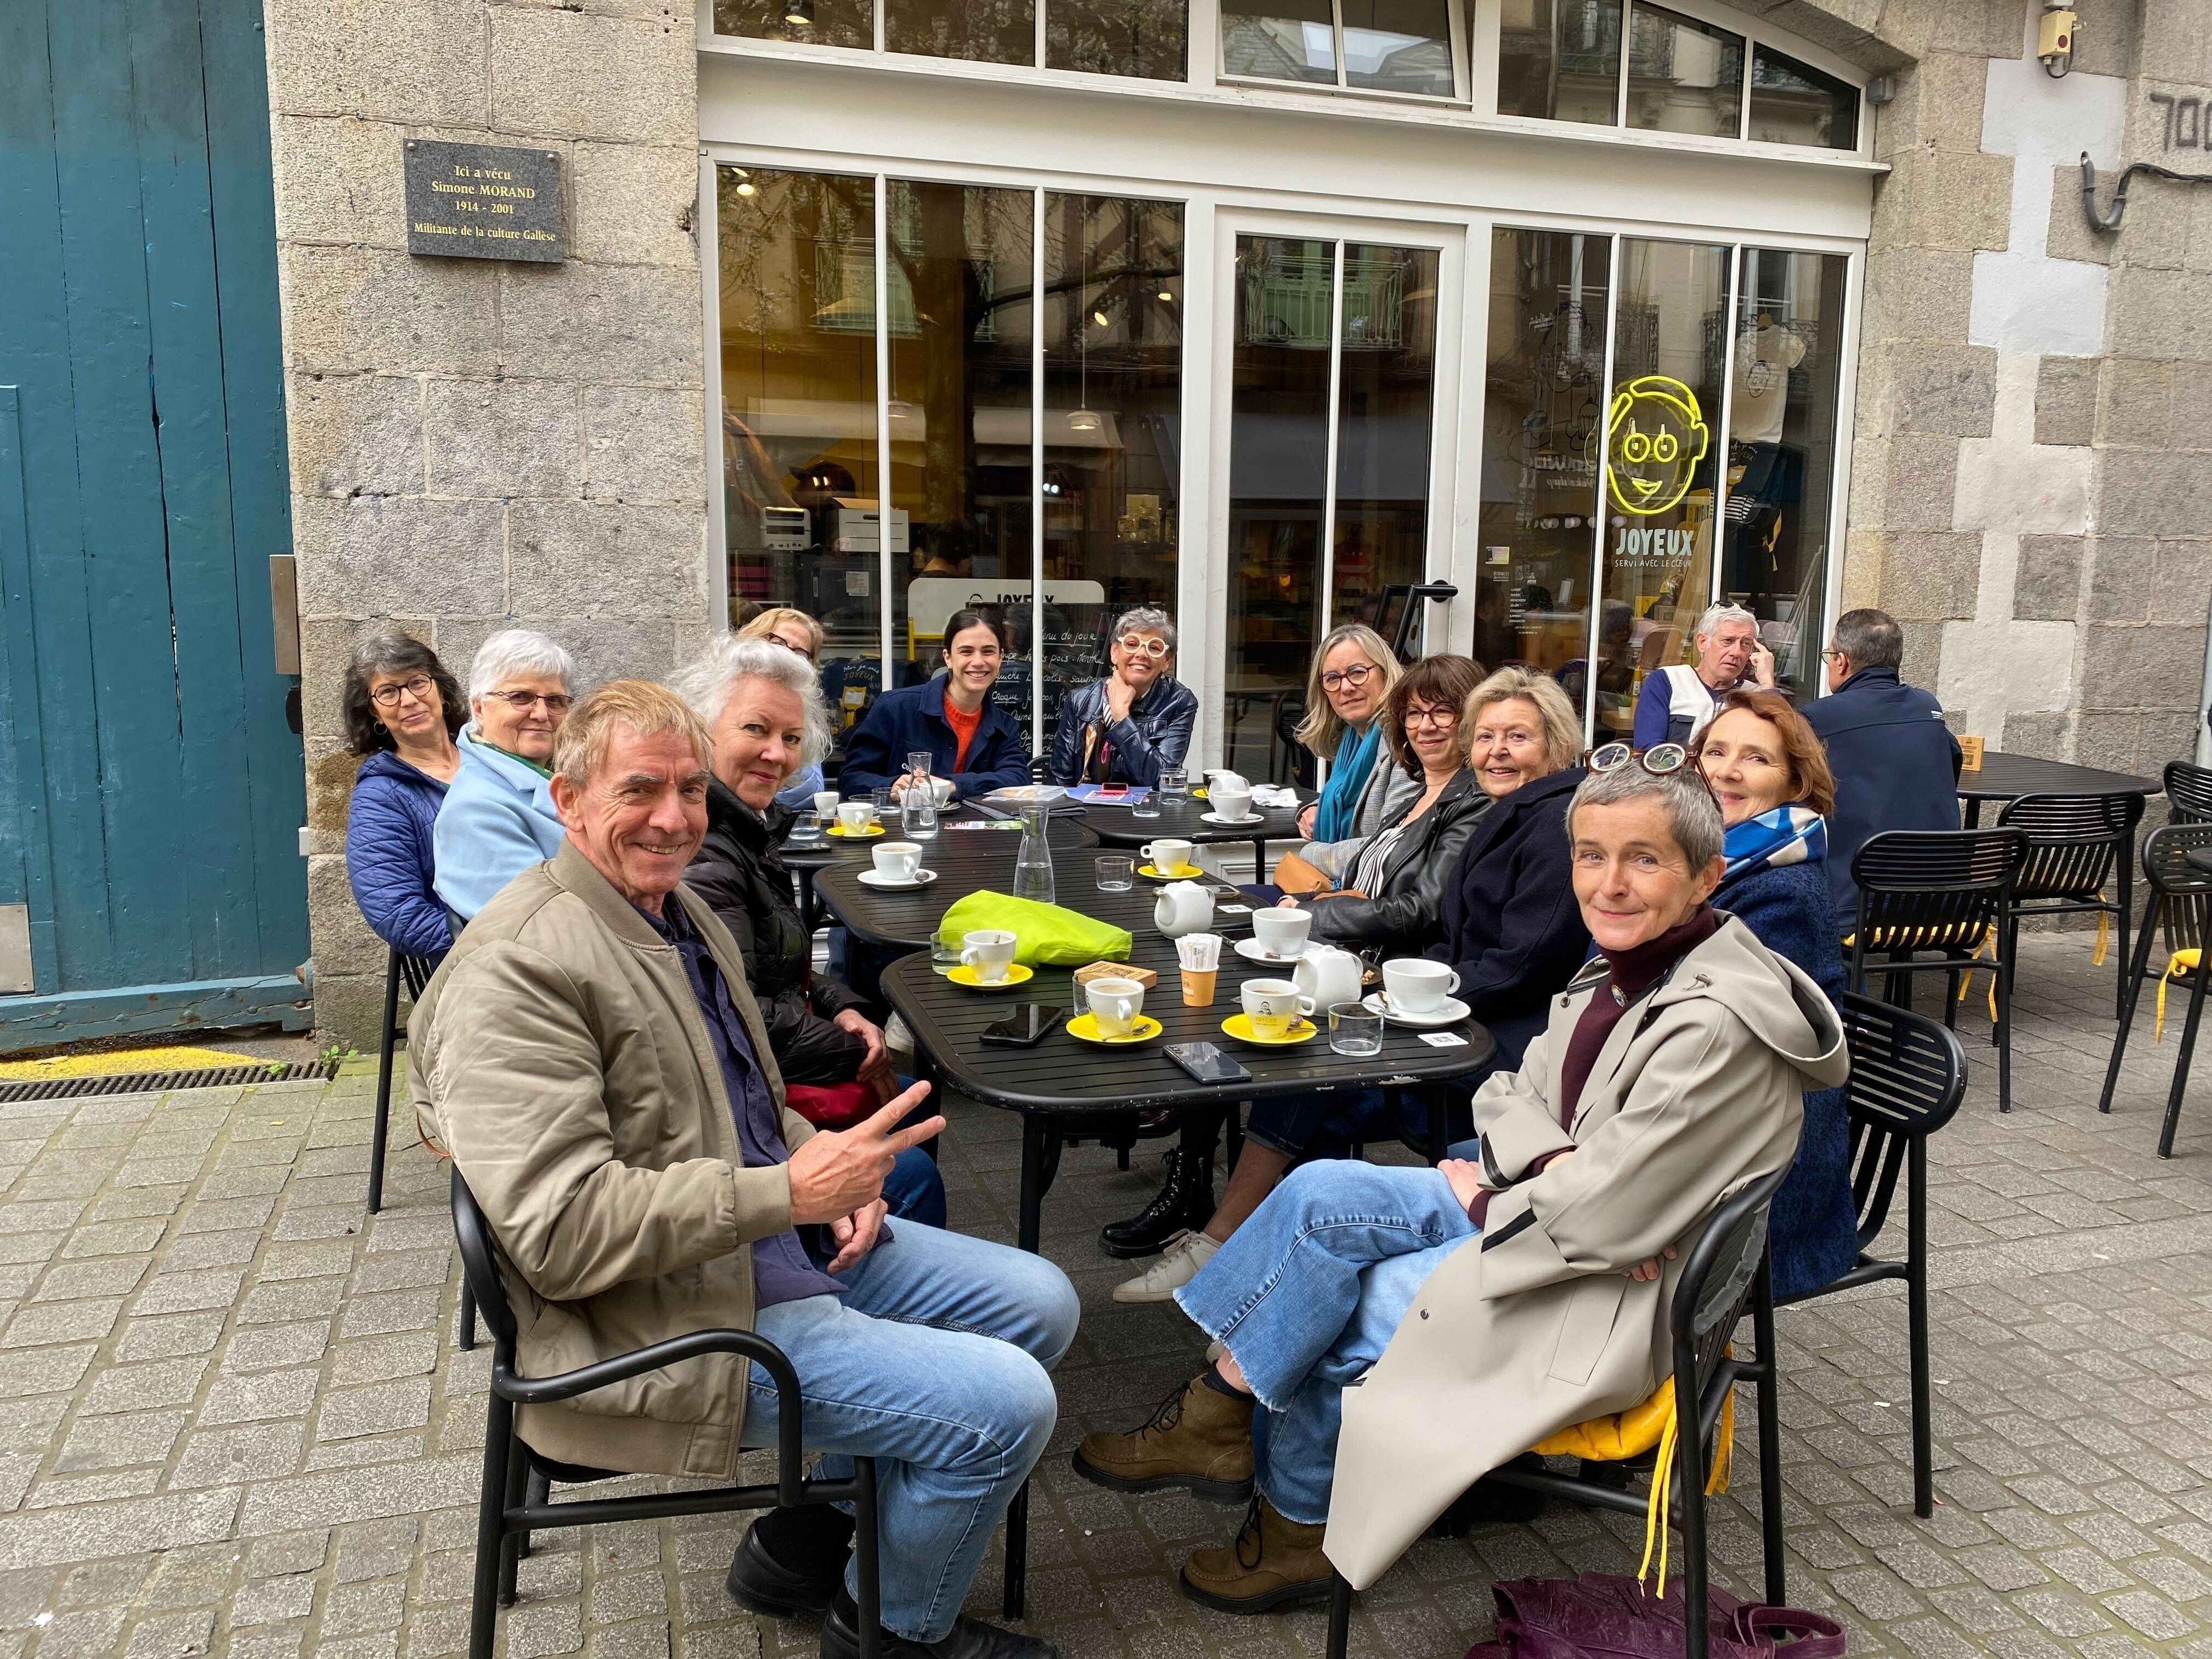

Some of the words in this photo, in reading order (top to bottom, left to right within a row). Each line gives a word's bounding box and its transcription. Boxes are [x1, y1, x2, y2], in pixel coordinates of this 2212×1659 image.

[455, 166, 470, 177] Ici
[474, 170, 481, 178] a
[485, 168, 511, 180] vécu
[432, 181, 475, 195] Simone
[479, 185, 535, 199] MORAND
[455, 201, 479, 212] 1914
[491, 203, 514, 214] 2001
[414, 222, 457, 235] Militante
[461, 225, 472, 236] de
[476, 226, 484, 236] la
[488, 229, 520, 239] culture
[523, 230, 556, 241] Gallèse
[1616, 528, 1694, 556] JOYEUX
[1042, 630, 1057, 641] enu
[843, 672, 874, 681] JOYEUX
